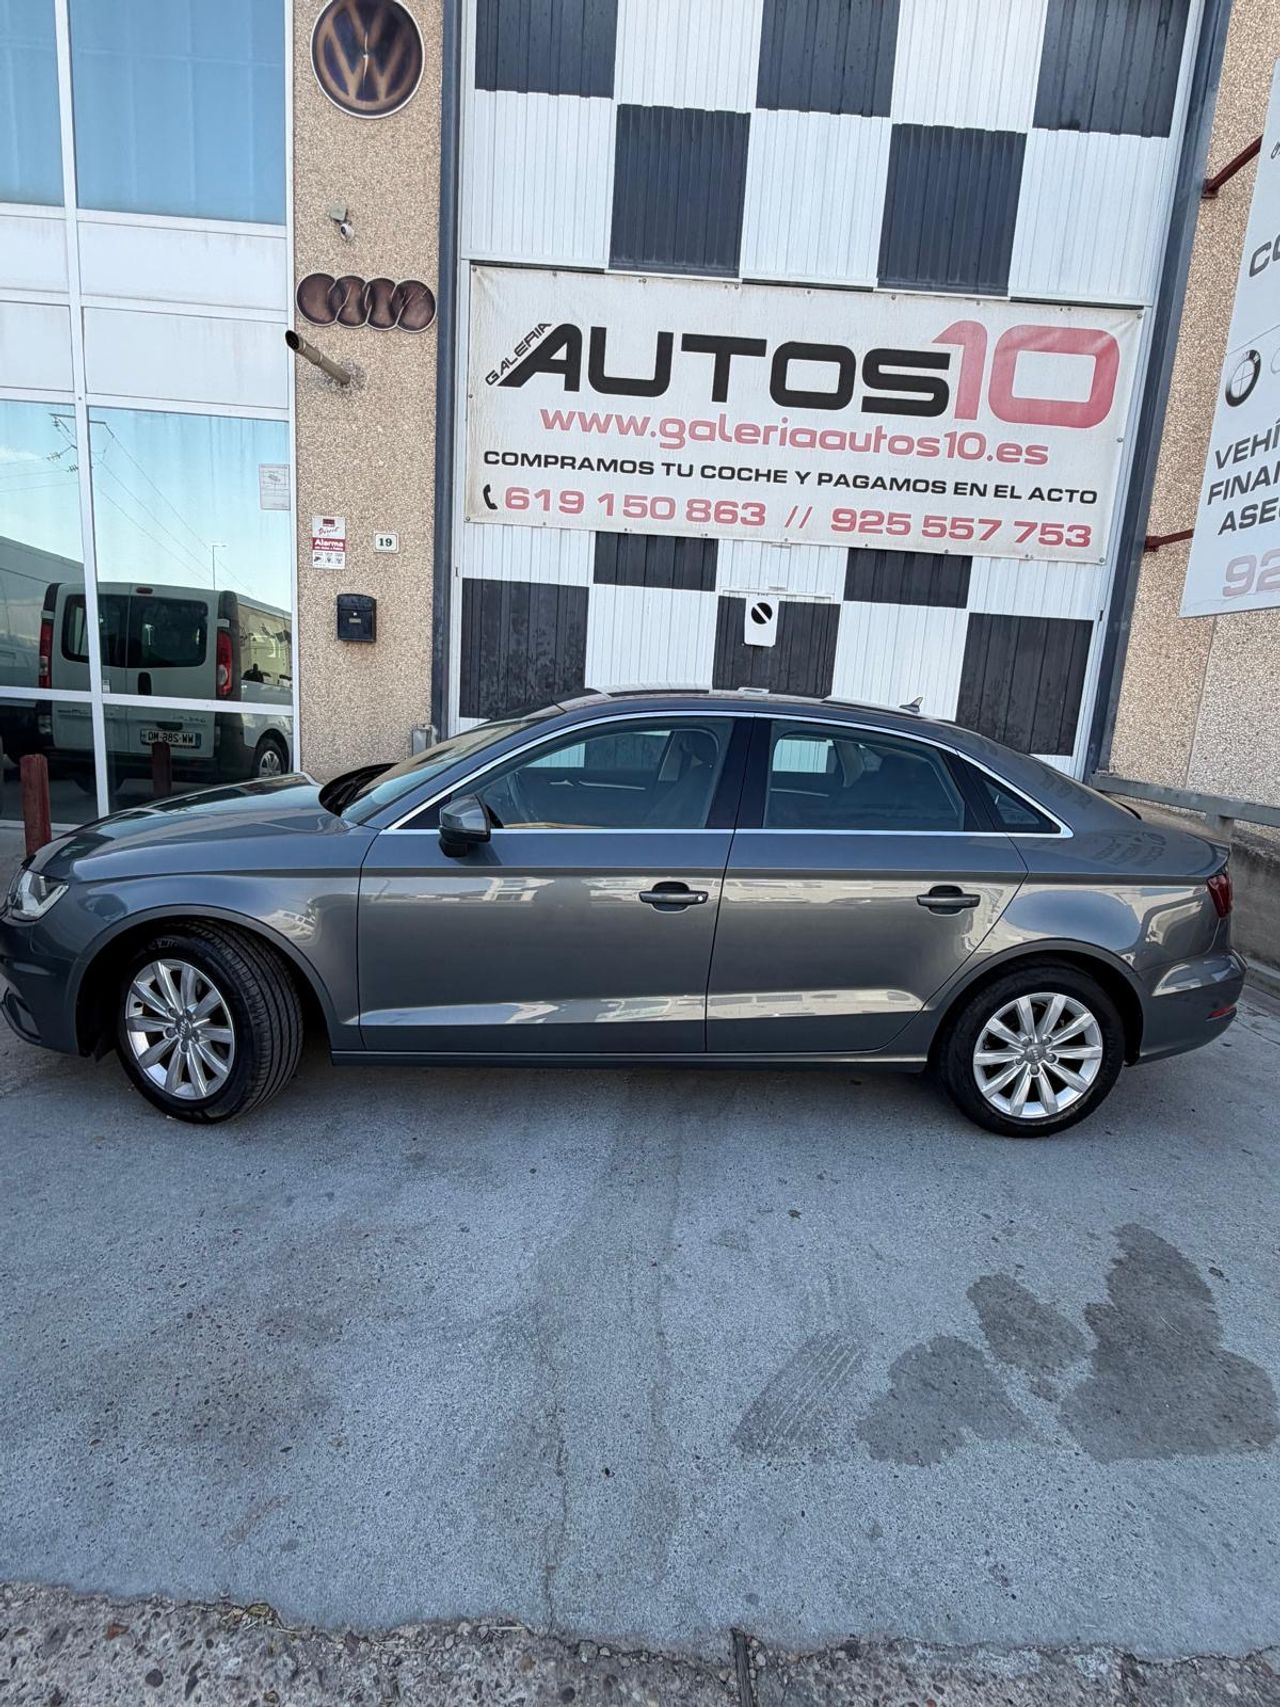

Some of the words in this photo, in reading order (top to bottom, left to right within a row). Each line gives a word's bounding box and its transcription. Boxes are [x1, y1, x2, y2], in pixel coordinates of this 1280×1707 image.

[485, 323, 552, 386] GALERIA
[540, 408, 1048, 466] www.galeriaautos10.es
[483, 450, 655, 476] COMPRAMOS
[661, 462, 694, 478] TU
[700, 464, 788, 484] COCHE
[794, 470, 811, 486] Y
[817, 472, 947, 495] PAGAMOS
[953, 481, 988, 498] EN
[994, 484, 1023, 501] EL
[1027, 486, 1098, 505] ACTO
[378, 537, 393, 547] 19
[504, 486, 585, 515] 619
[598, 492, 677, 521] 150
[685, 497, 767, 527] 863
[830, 507, 913, 536] 925
[921, 513, 1003, 542] 557
[1013, 520, 1093, 548] 753
[1217, 497, 1280, 536] ASE
